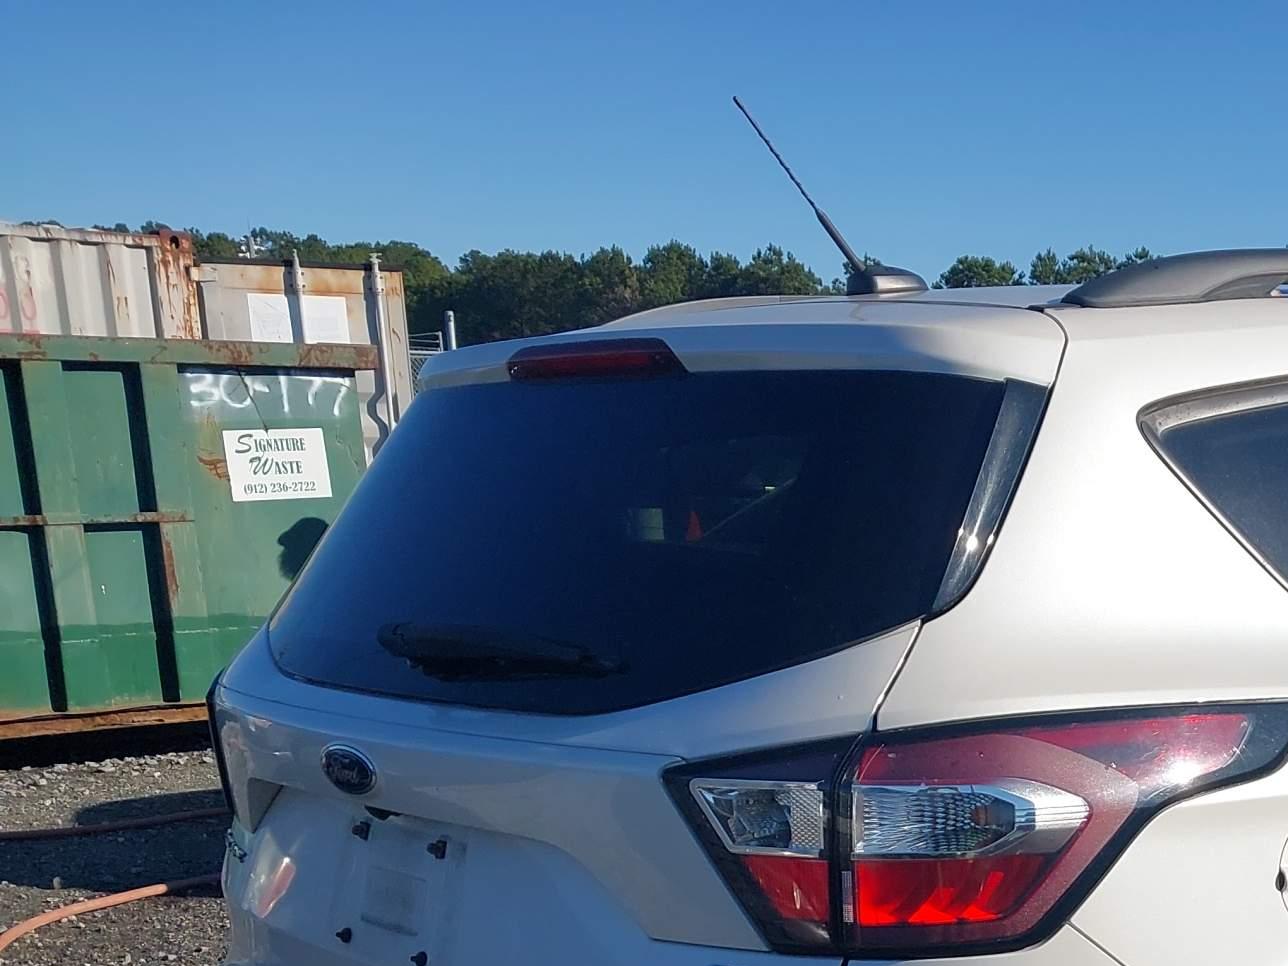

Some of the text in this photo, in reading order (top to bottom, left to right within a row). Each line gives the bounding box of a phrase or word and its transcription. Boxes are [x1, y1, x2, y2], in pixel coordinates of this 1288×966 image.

[235, 434, 306, 454] SIGNATURE
[249, 456, 304, 475] WASTE
[244, 481, 317, 495] (912) 236-2722
